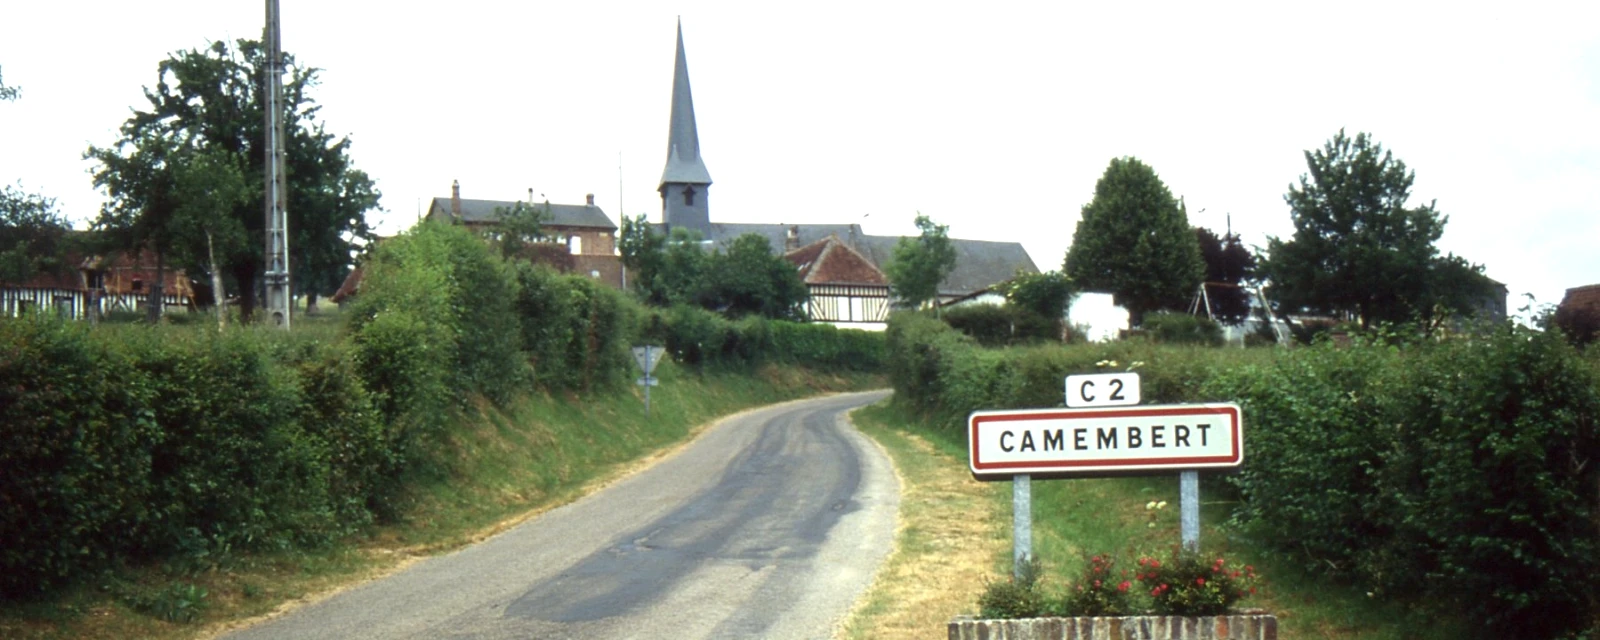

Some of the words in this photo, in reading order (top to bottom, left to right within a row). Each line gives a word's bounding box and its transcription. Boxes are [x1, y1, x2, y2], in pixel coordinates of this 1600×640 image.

[1080, 380, 1095, 402] C
[1109, 379, 1125, 401] 2
[999, 424, 1211, 453] CAMEMBERT
